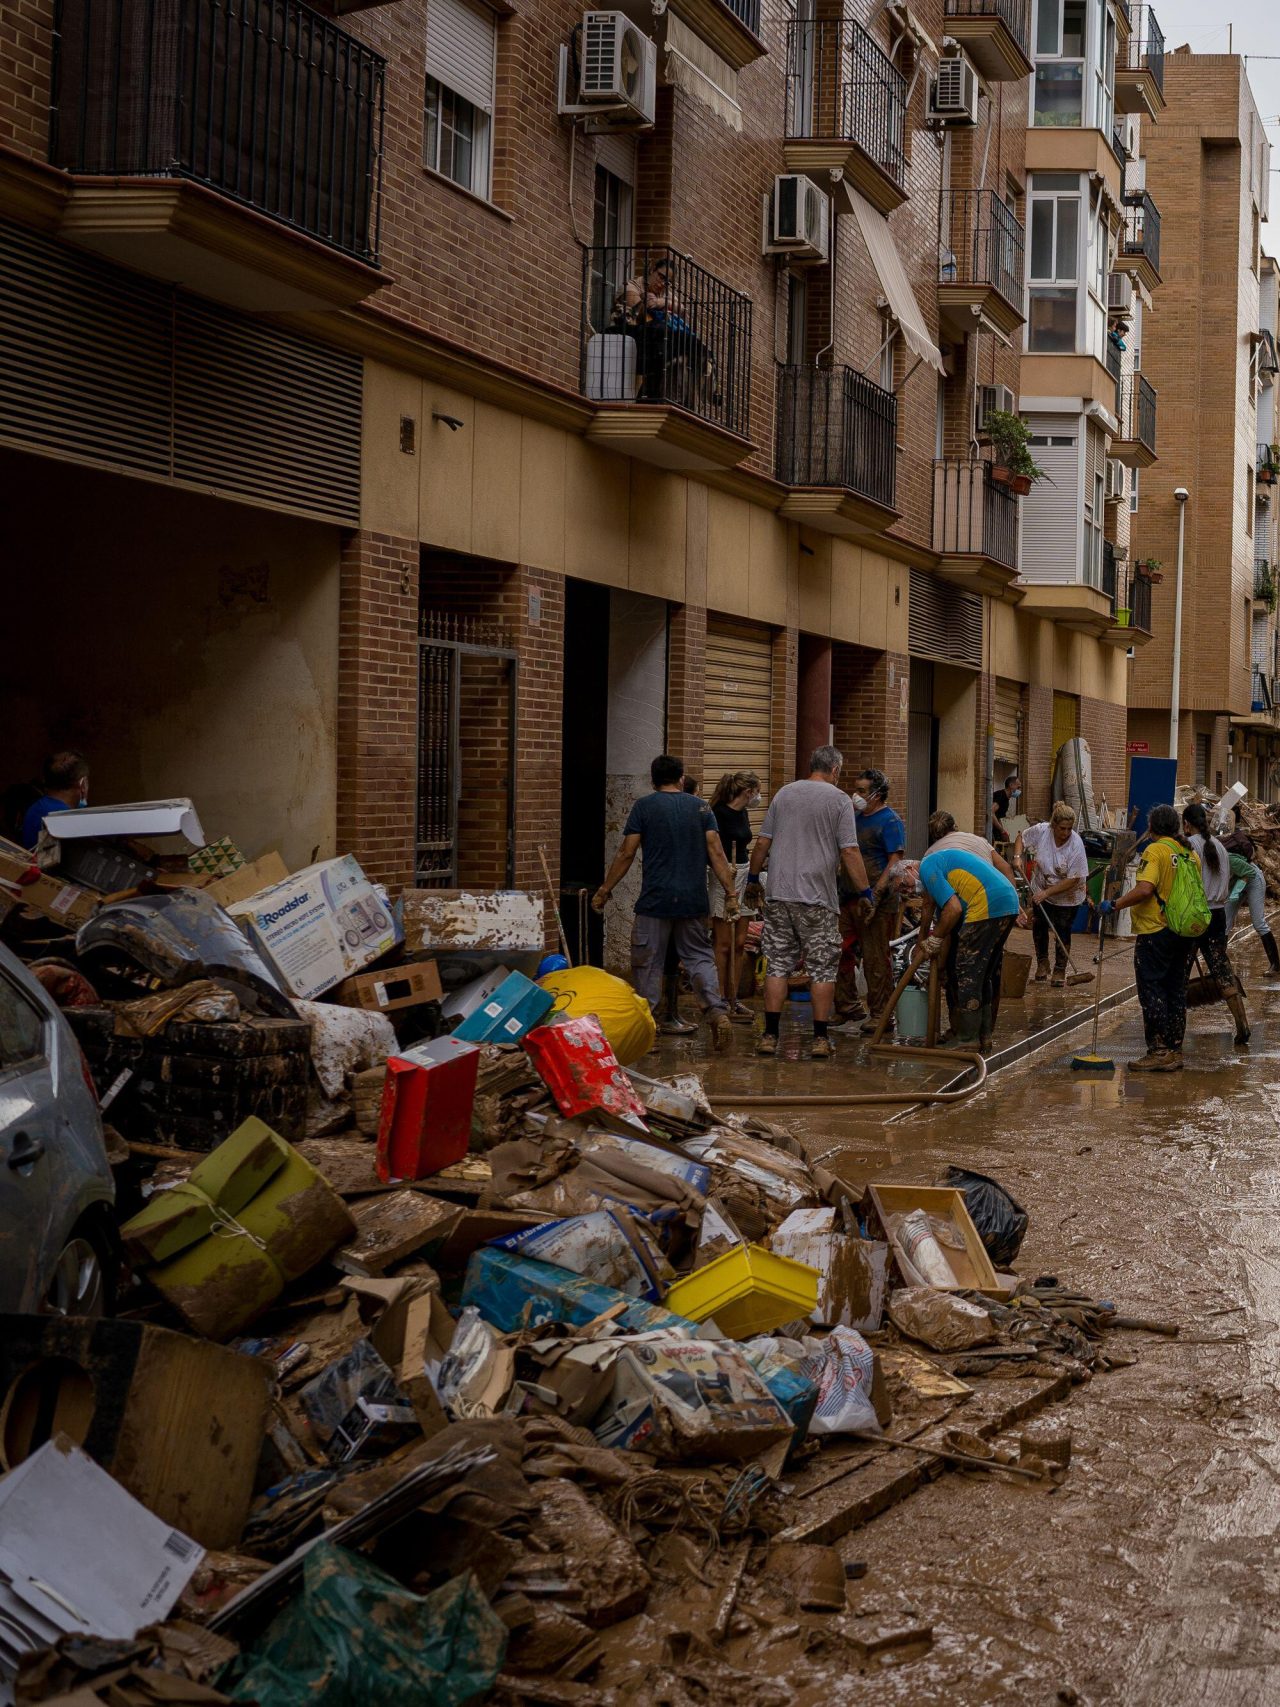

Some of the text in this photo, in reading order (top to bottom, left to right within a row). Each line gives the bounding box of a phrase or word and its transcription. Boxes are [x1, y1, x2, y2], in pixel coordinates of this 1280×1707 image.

[264, 892, 309, 924] Roadstar
[265, 928, 283, 941] STEREO
[283, 919, 299, 930] MICRO
[309, 902, 325, 915] SYSTEM
